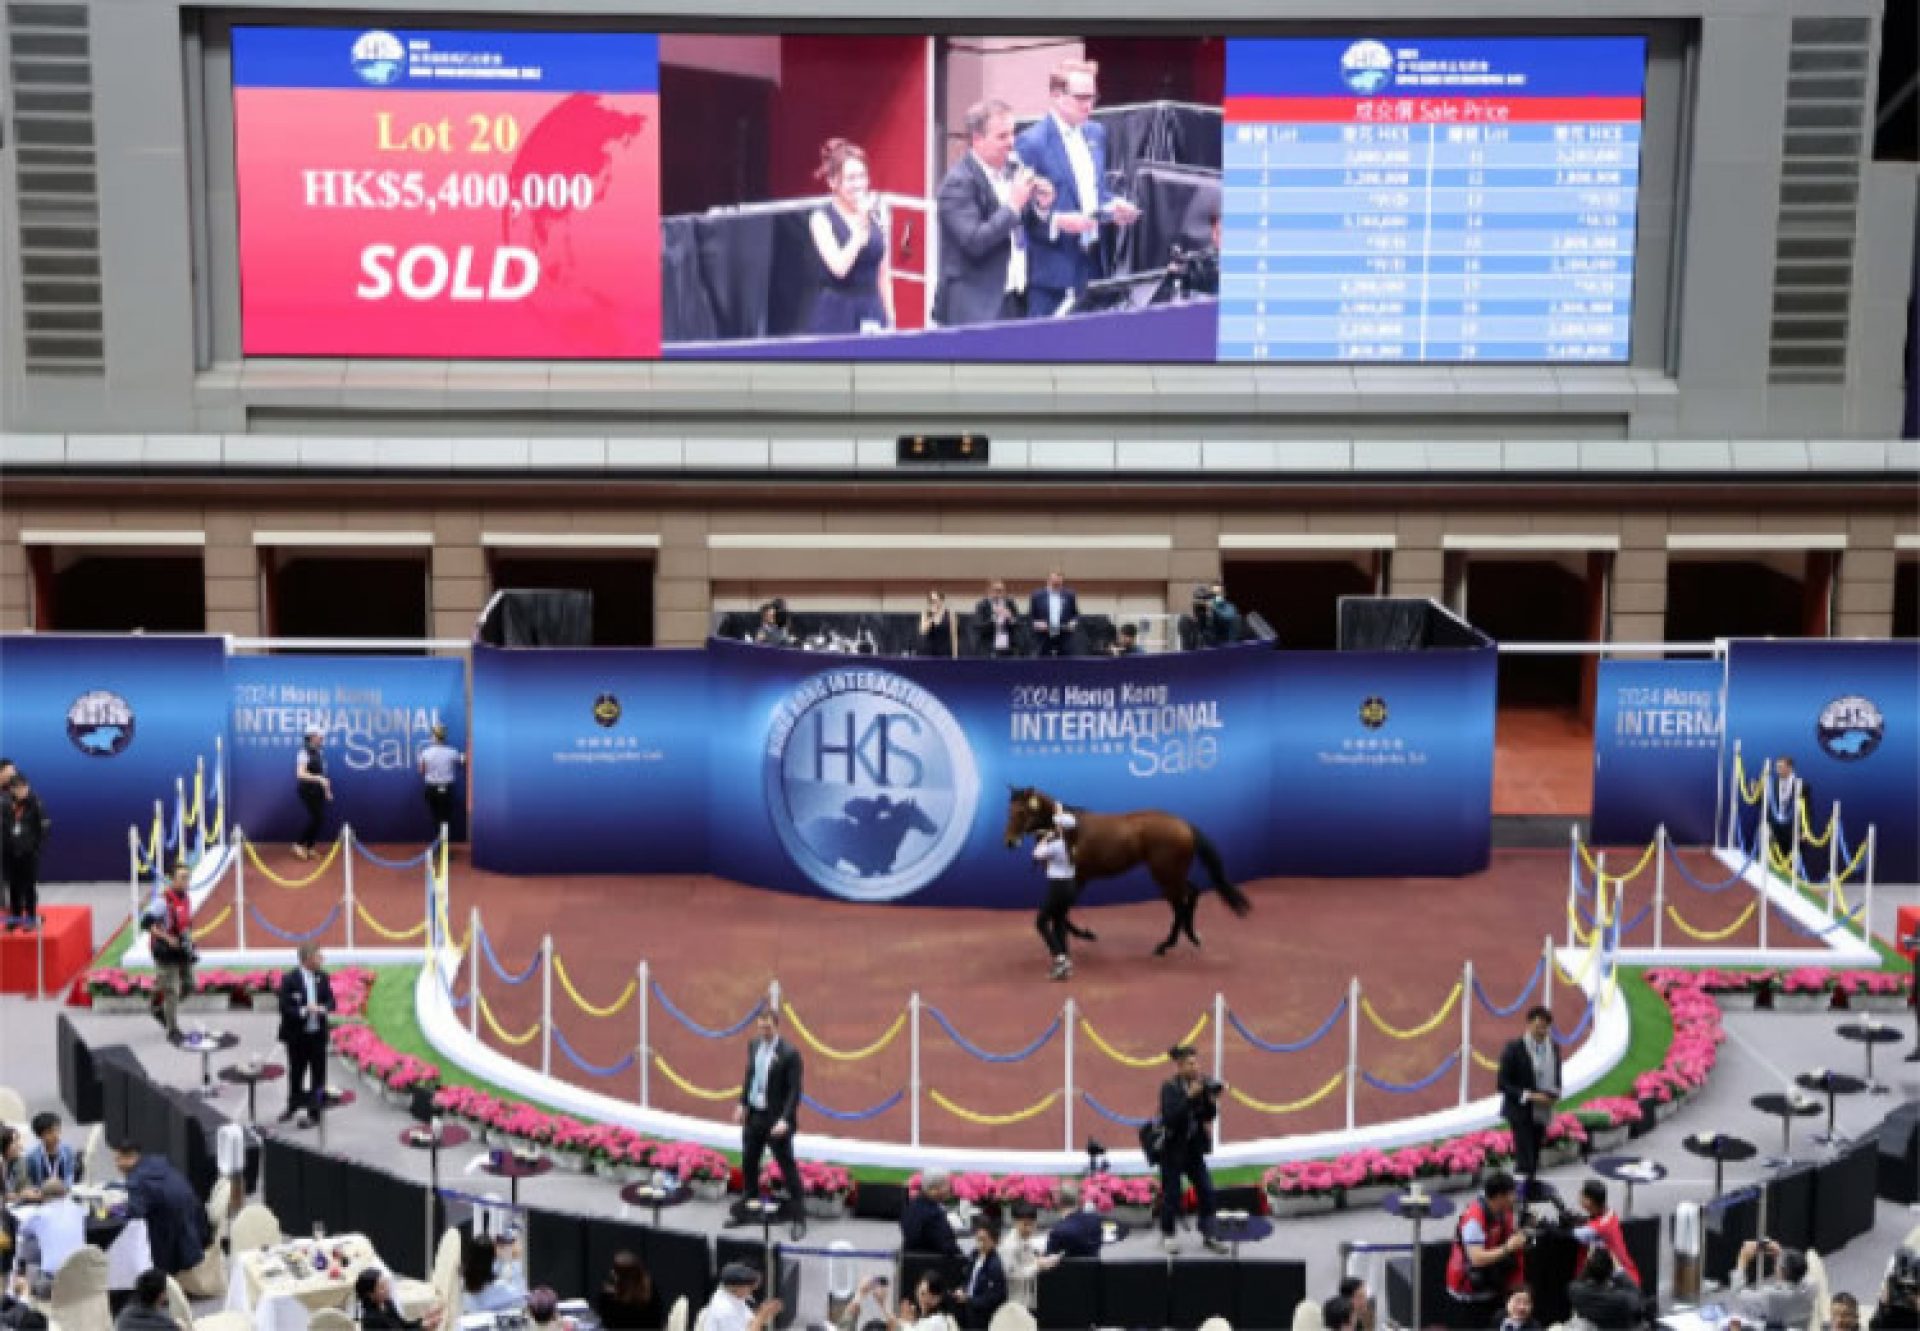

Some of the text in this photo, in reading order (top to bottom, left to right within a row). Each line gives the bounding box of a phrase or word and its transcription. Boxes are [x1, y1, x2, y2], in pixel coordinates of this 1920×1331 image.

[1420, 101, 1458, 120] Sale
[1464, 100, 1508, 120] Price
[376, 111, 519, 152] Lot 20
[302, 168, 594, 215] HK$5,400,000
[356, 243, 540, 301] SOLD
[281, 686, 329, 706] Hong
[1010, 681, 1169, 708] 2024 Hong Kong
[234, 705, 441, 733] INTERNATIONAL
[1010, 700, 1225, 741] INTERNATIONAL
[1128, 731, 1218, 778] Sale
